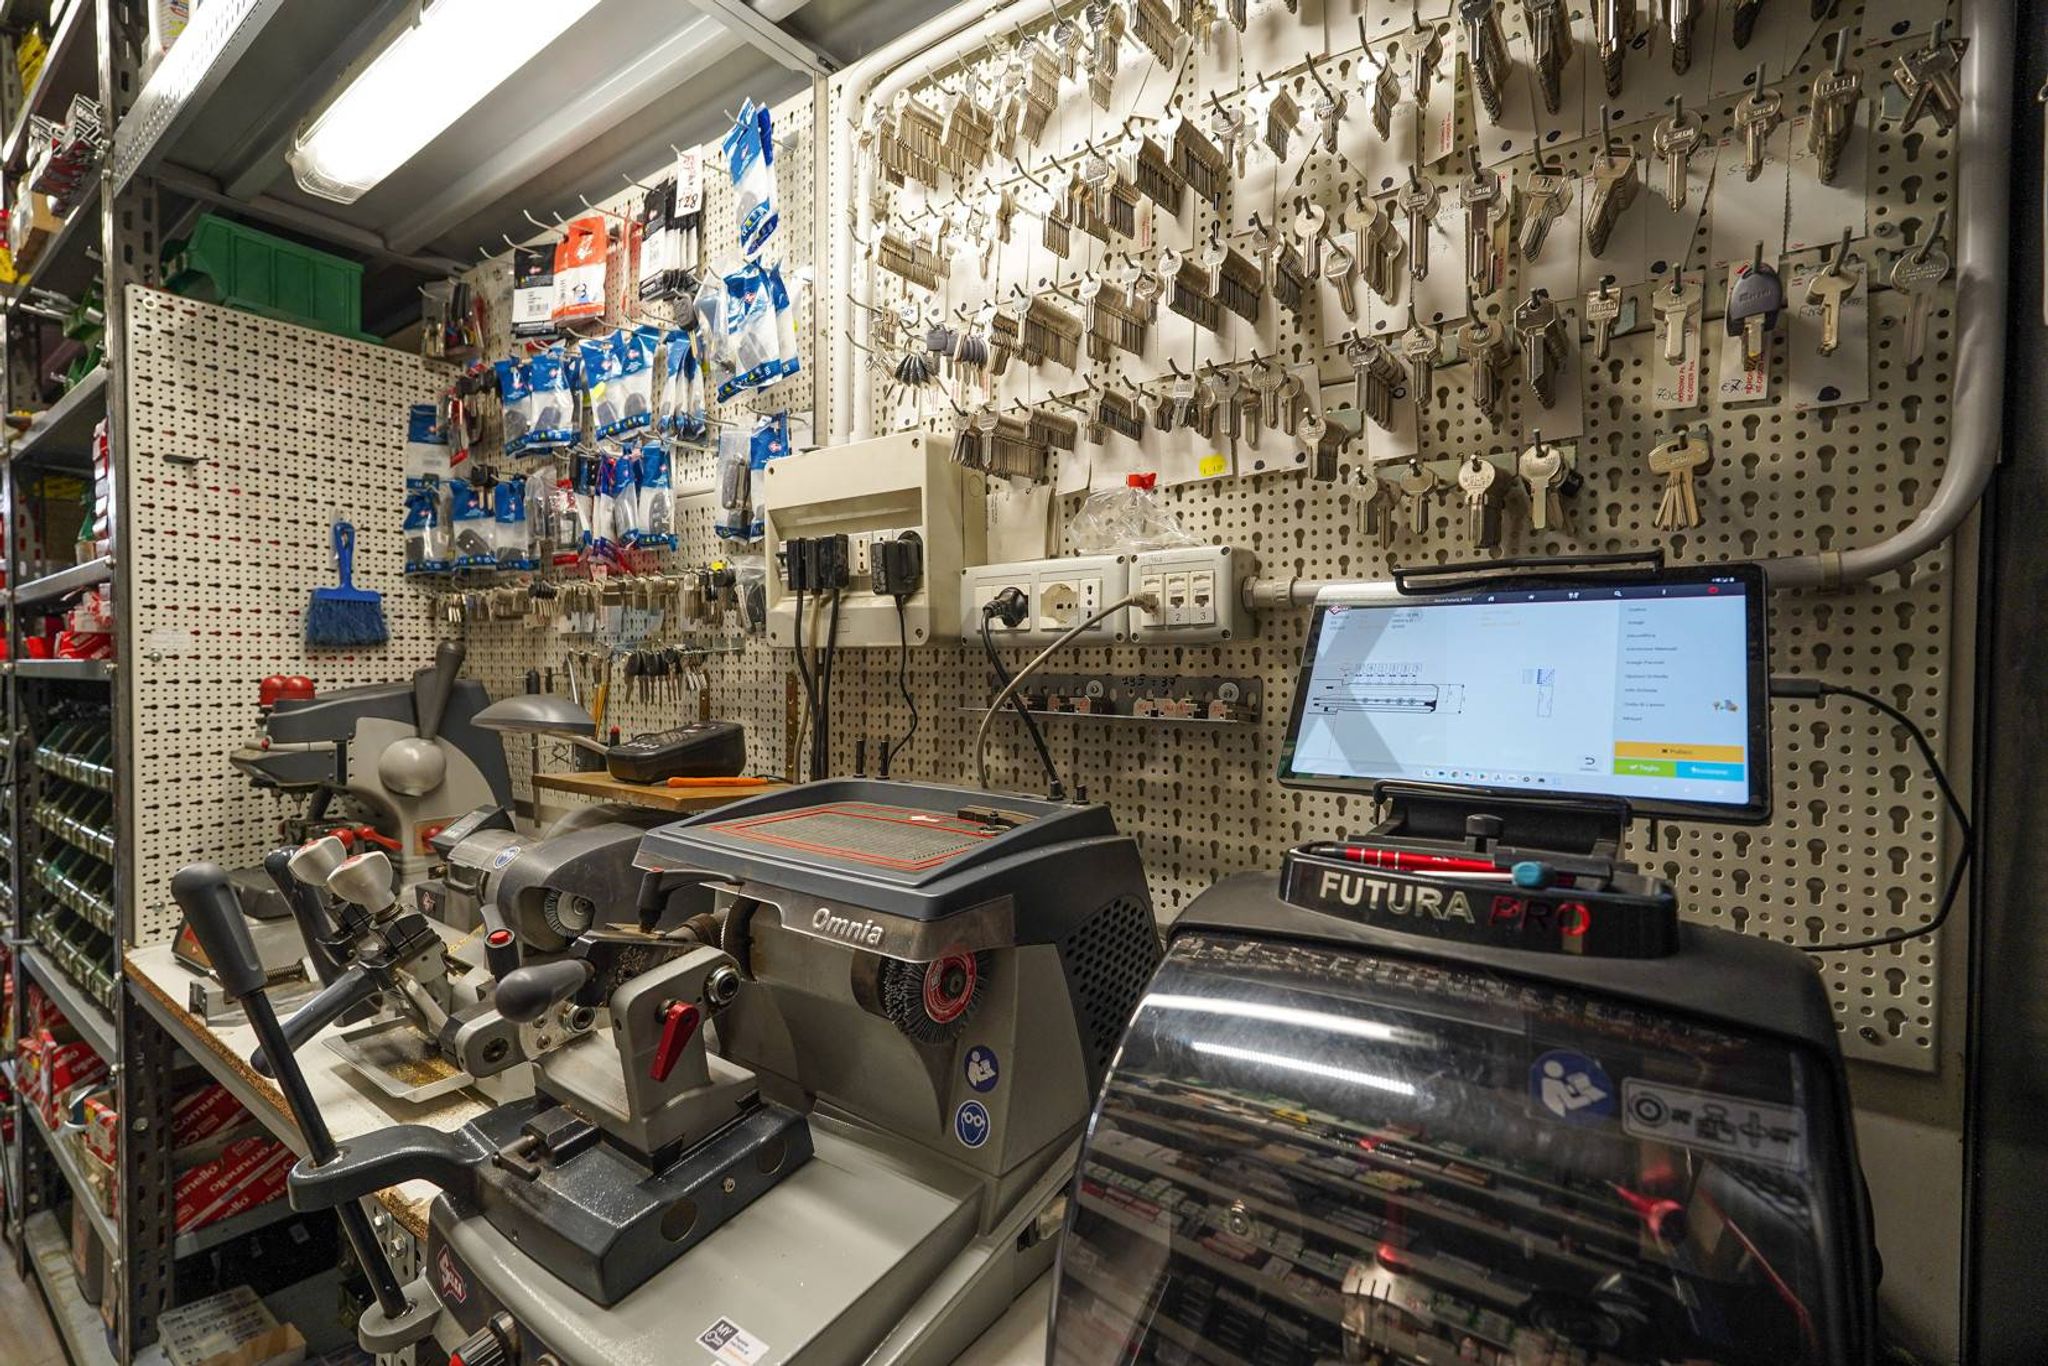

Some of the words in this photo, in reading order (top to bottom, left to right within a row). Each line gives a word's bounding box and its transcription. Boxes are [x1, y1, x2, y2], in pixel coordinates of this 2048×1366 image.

[812, 907, 885, 946] Omnia
[1319, 870, 1475, 925] FUTURA
[1489, 895, 1591, 938] PRO
